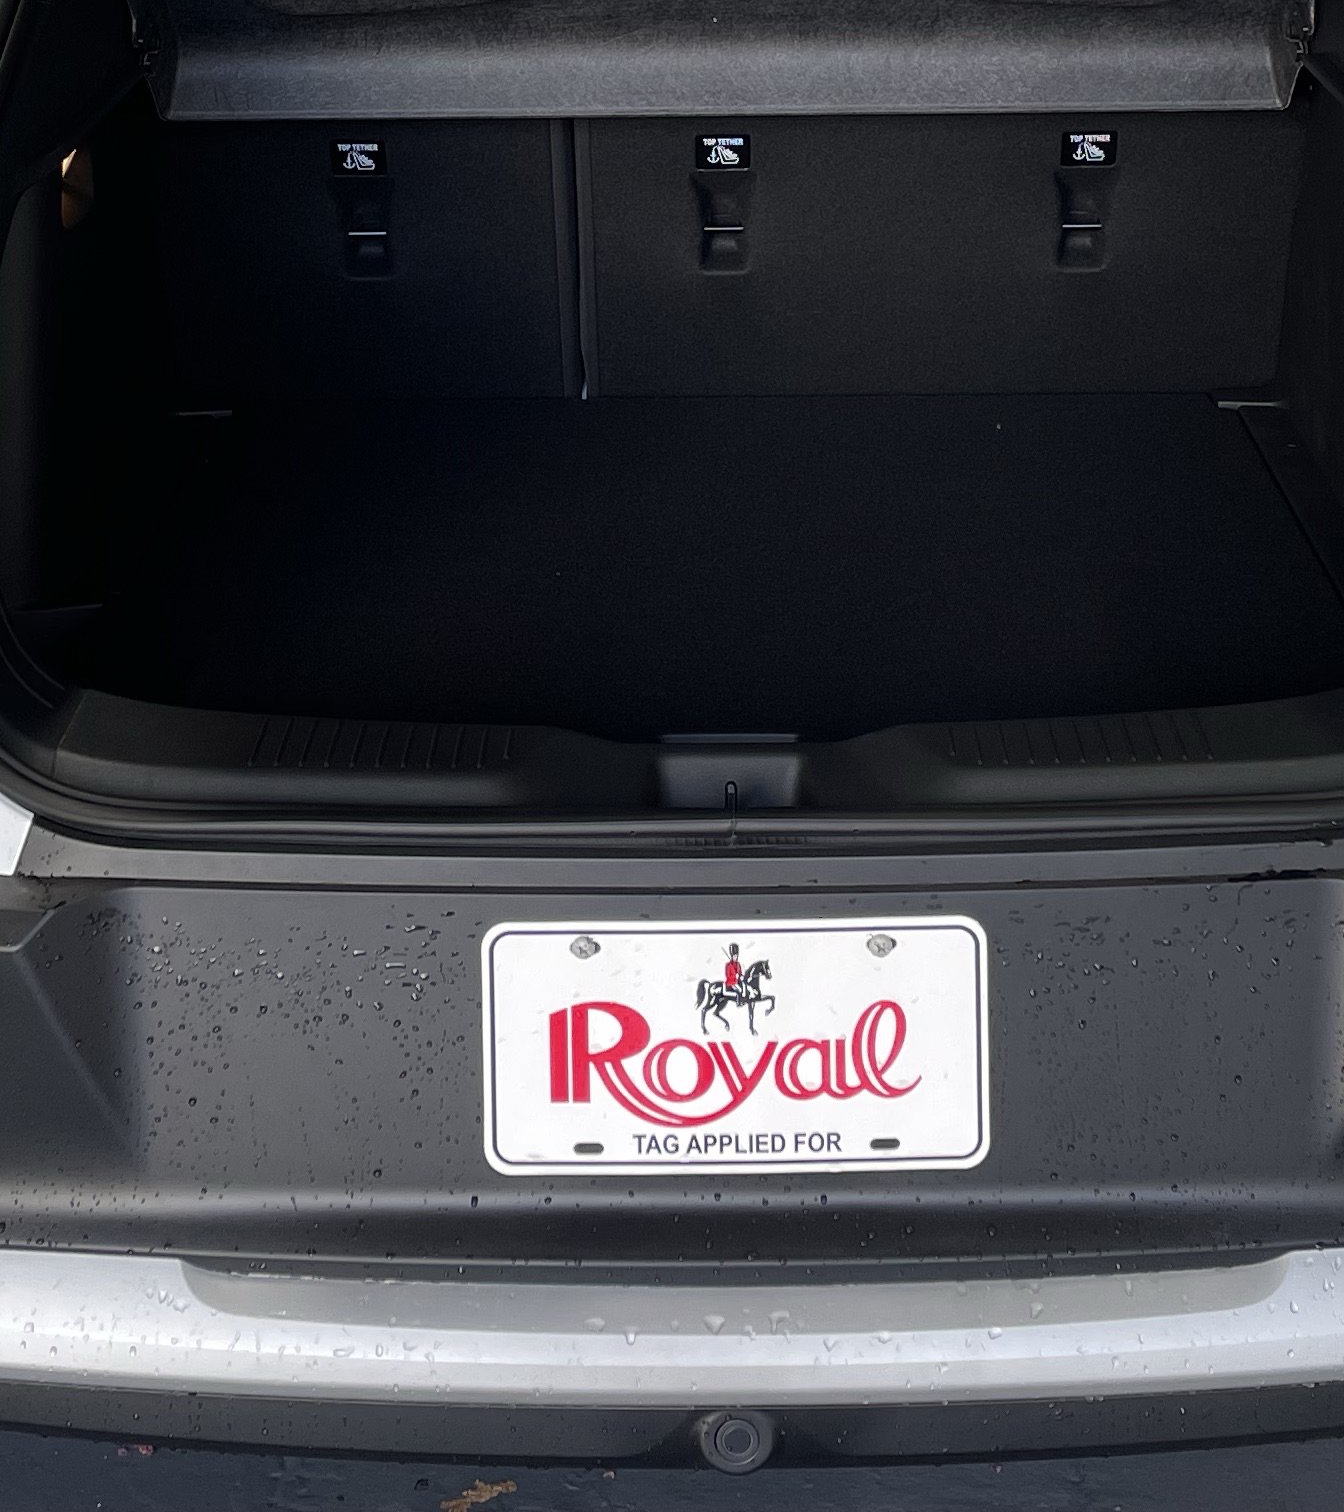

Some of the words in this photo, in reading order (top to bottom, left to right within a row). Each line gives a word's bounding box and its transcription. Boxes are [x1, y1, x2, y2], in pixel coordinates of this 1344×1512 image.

[549, 999, 922, 1128] Royal
[633, 1134, 681, 1154] TAG
[686, 1133, 787, 1154] APPLIED
[794, 1131, 843, 1153] FOR
